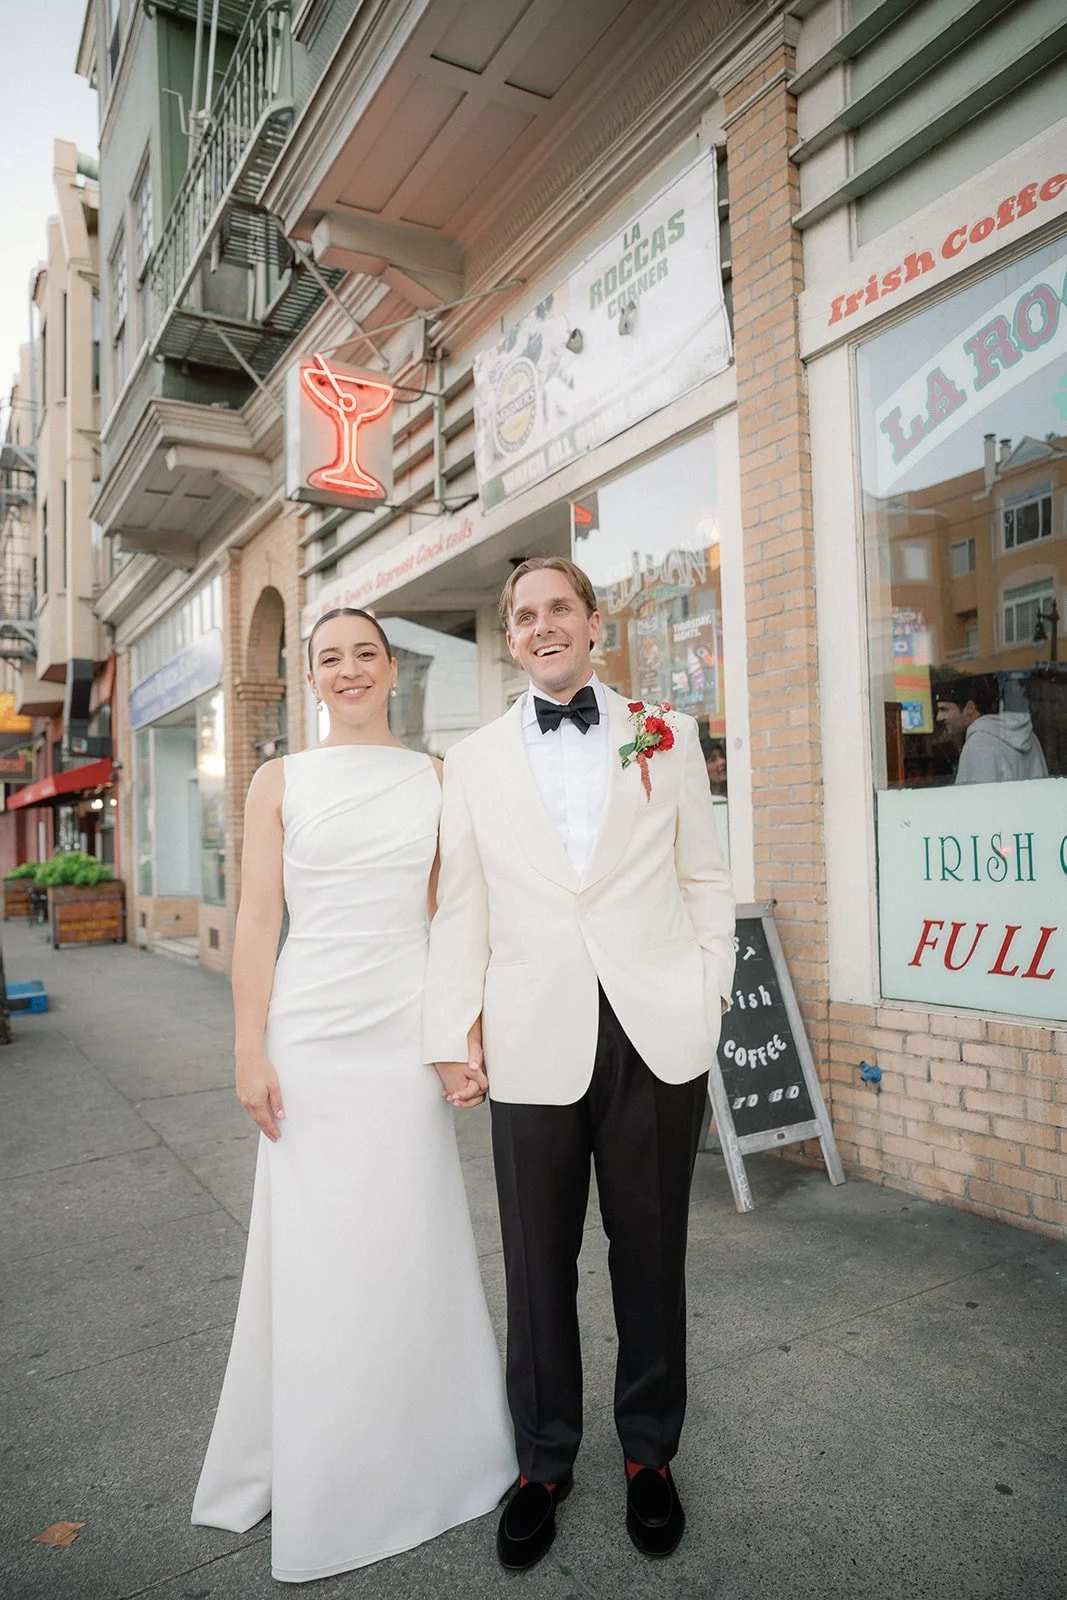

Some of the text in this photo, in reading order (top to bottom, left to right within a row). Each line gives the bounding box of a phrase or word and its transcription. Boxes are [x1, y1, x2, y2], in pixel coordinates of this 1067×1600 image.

[589, 209, 685, 312] ROCCAS
[623, 222, 641, 251] LA
[607, 258, 669, 321] CORNER
[828, 250, 936, 327] Irish
[880, 268, 1067, 465] LA RO
[922, 831, 1037, 883] IRISH
[907, 919, 1058, 981] FULL
[723, 1033, 787, 1070] COFFEE
